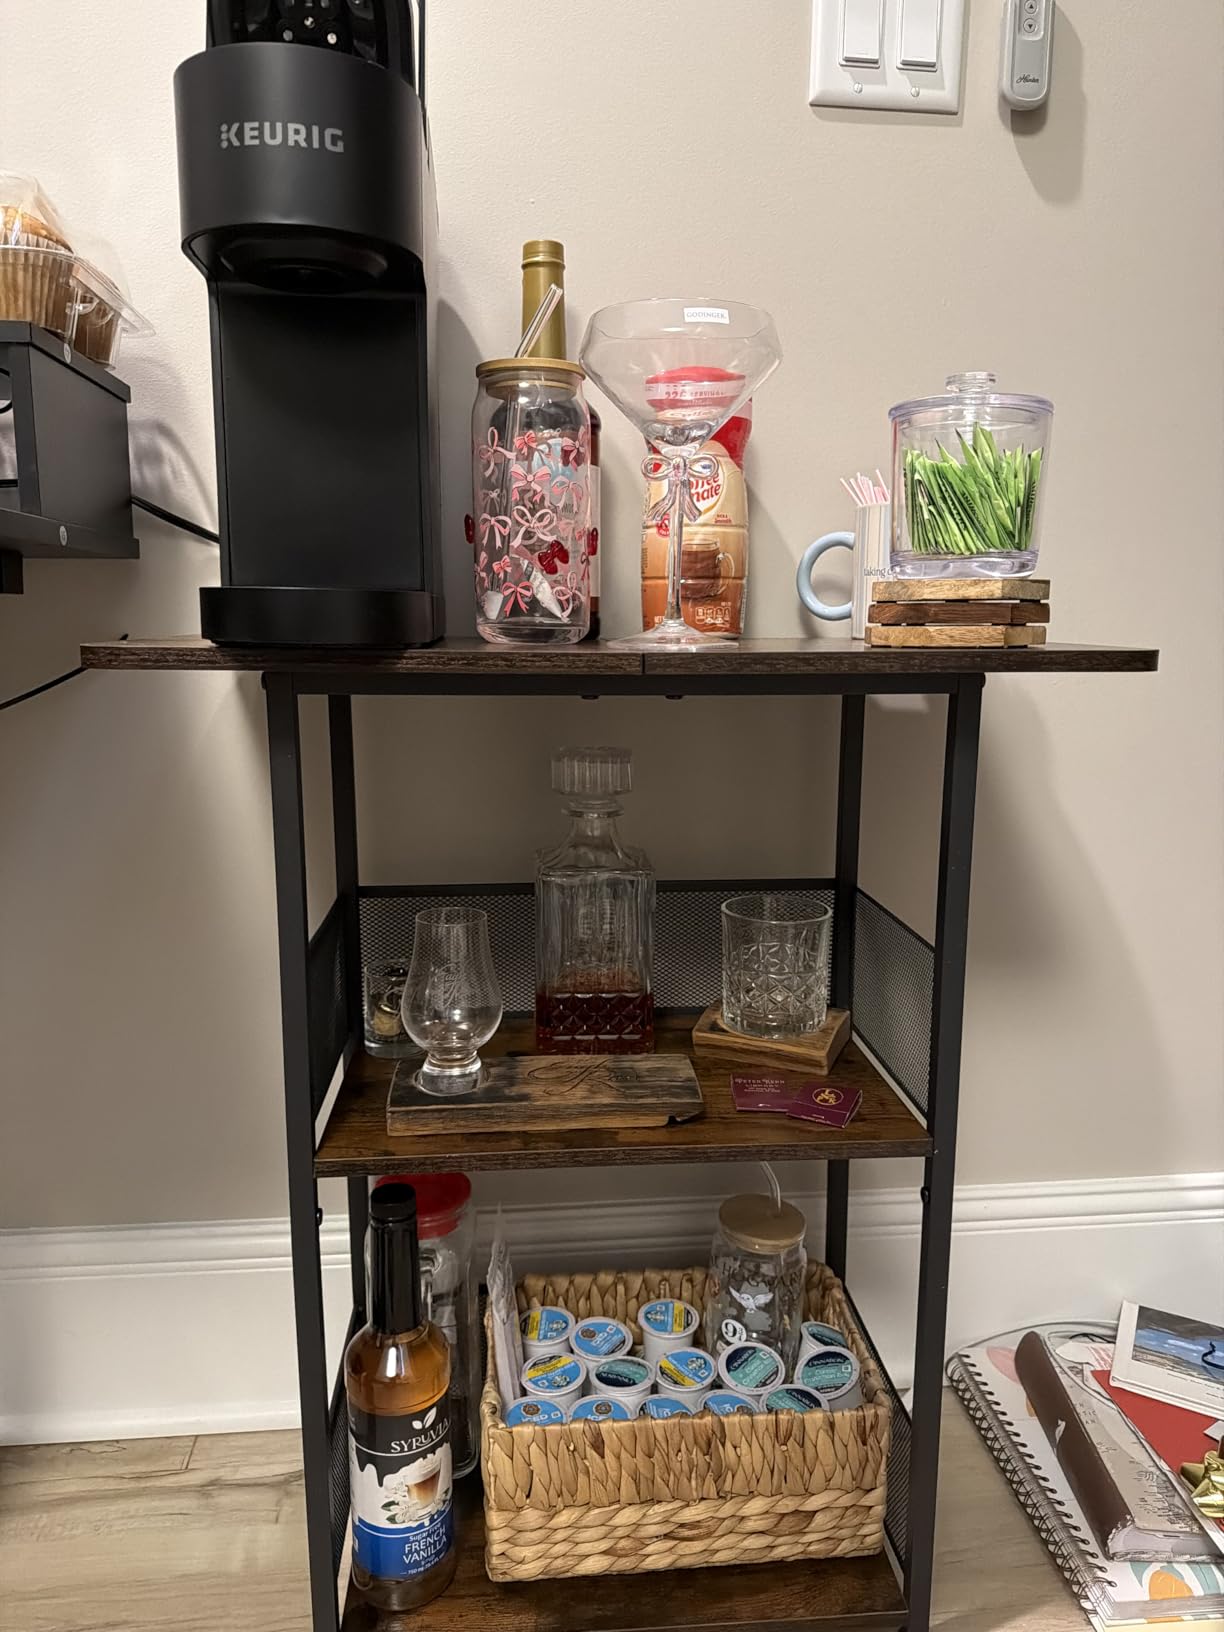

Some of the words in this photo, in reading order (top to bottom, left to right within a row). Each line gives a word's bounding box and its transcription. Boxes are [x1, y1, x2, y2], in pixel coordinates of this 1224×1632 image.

[220, 121, 344, 153] KEURIG
[864, 567, 886, 578] taking
[391, 1418, 450, 1454] SYRUVIA
[402, 1535, 447, 1564] VANILLA
[405, 1524, 446, 1554] FRENCH
[409, 1531, 428, 1542] Sugar
